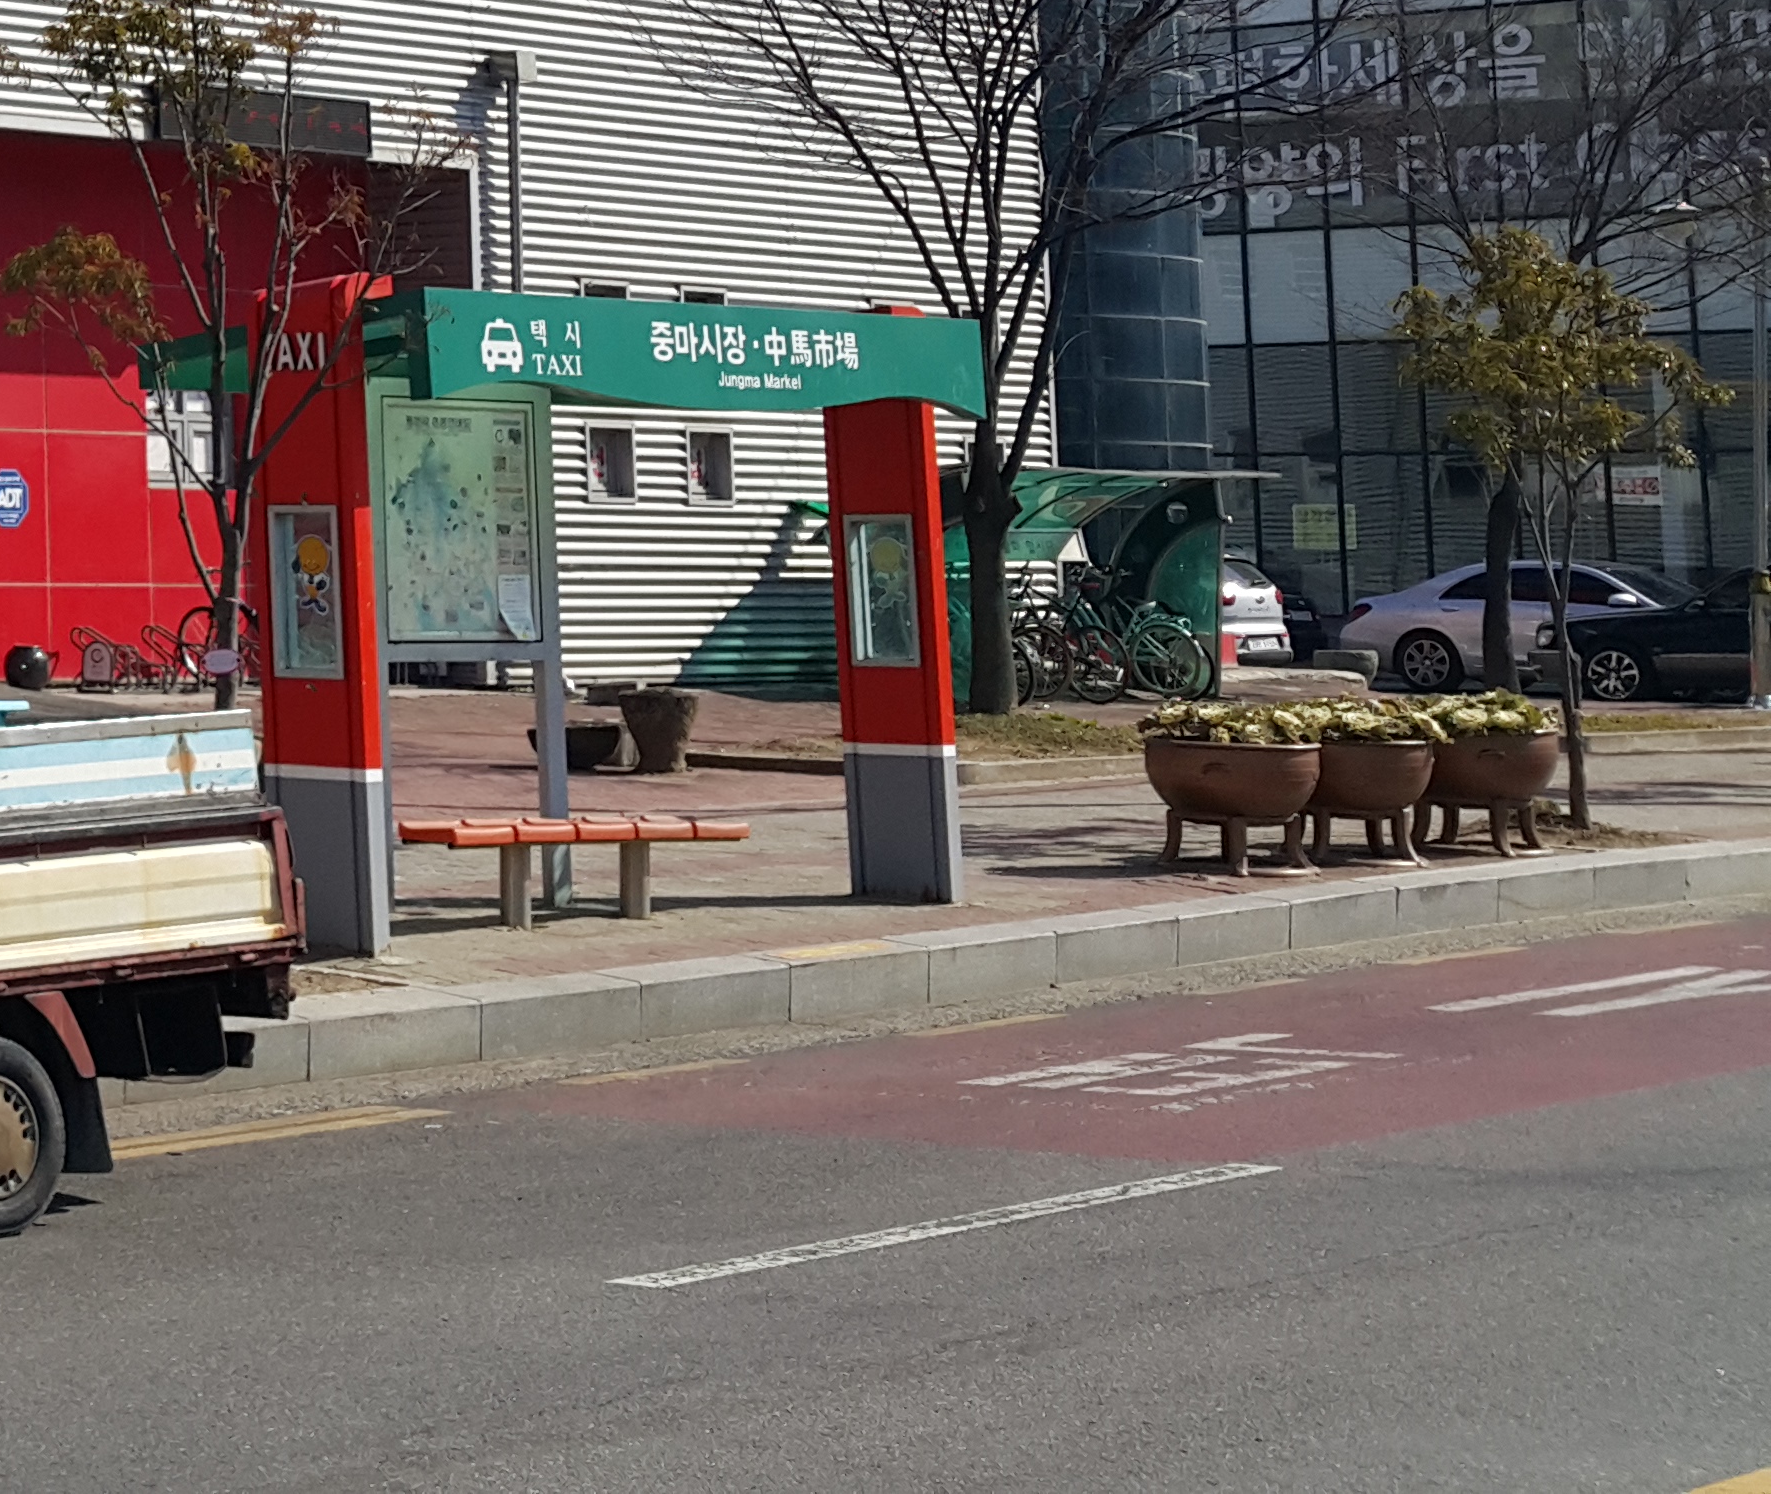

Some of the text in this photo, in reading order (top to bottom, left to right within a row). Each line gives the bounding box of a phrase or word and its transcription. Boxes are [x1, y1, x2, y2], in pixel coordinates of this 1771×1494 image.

[265, 331, 326, 371] AXI
[532, 353, 584, 376] TAXI
[718, 371, 761, 390] Jungma
